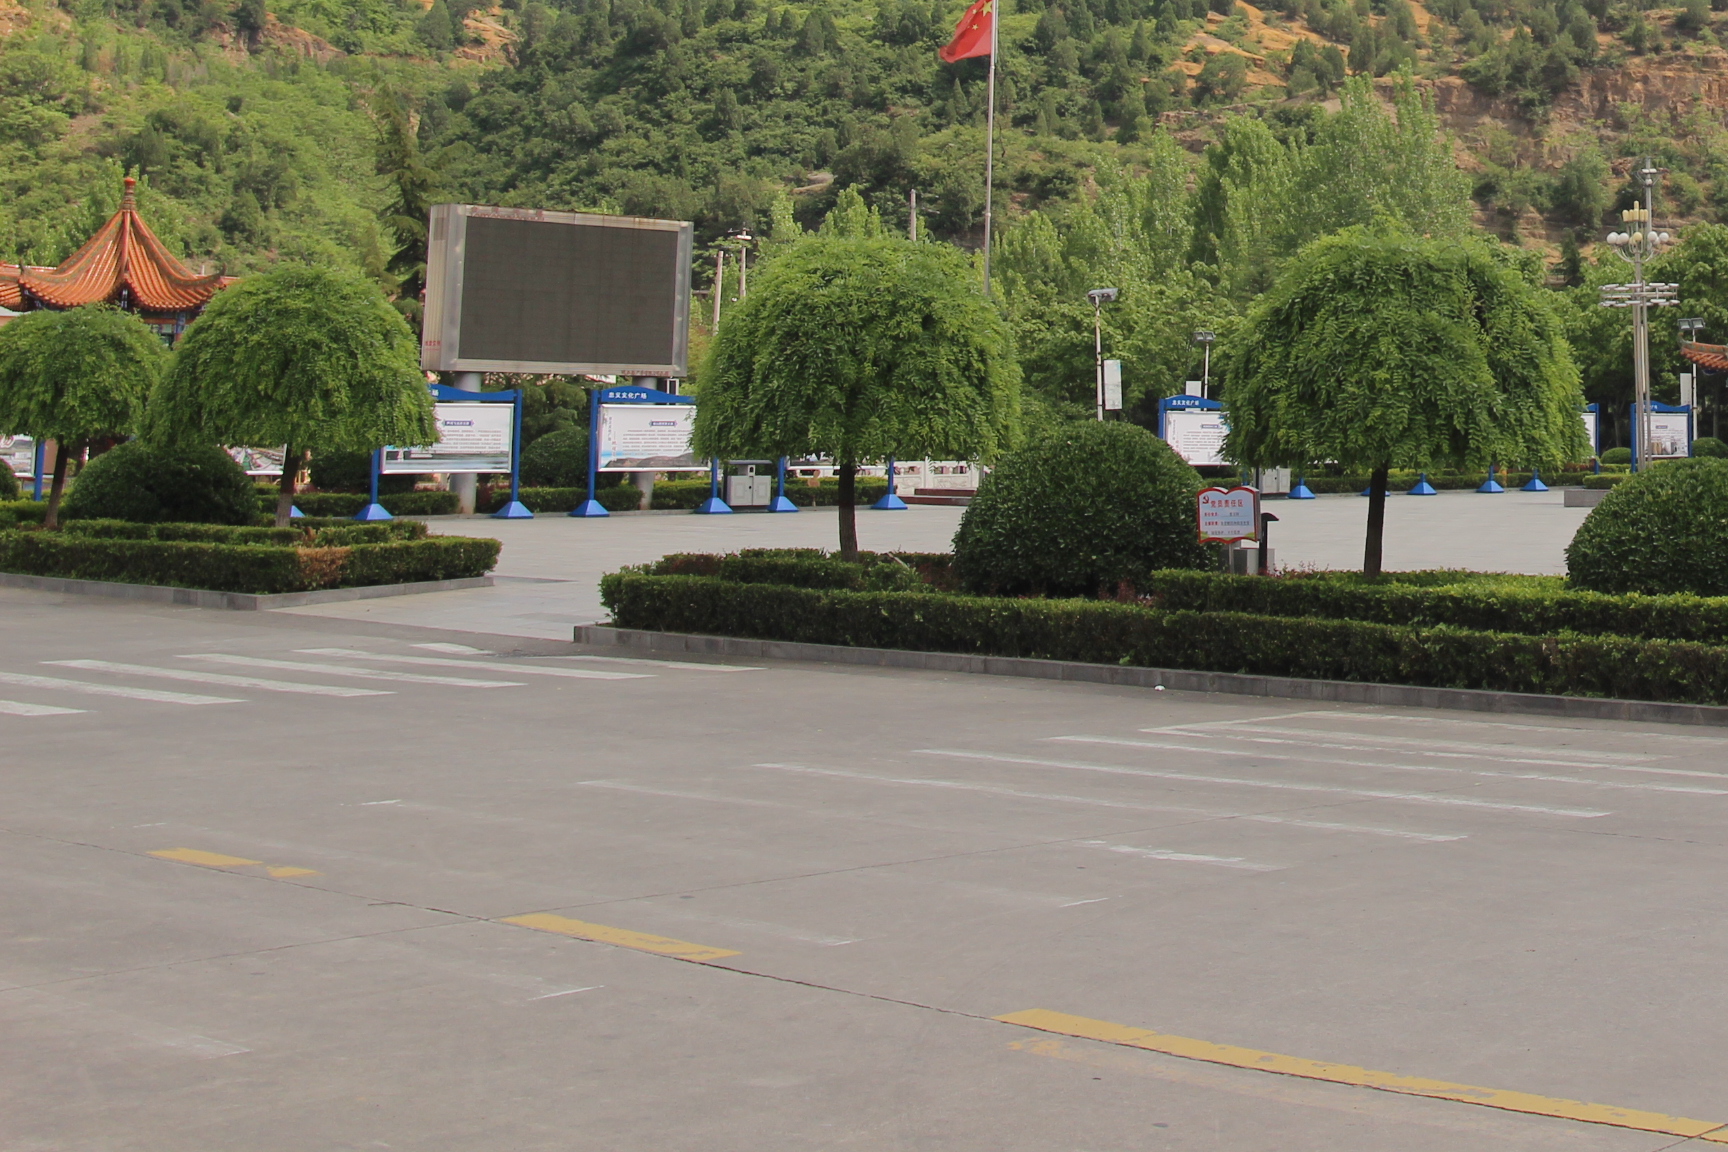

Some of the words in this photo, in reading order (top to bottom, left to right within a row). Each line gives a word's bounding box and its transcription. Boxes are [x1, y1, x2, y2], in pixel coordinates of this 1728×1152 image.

[608, 392, 647, 400] 忠义文化广场
[1210, 499, 1244, 508] 党员责任区
